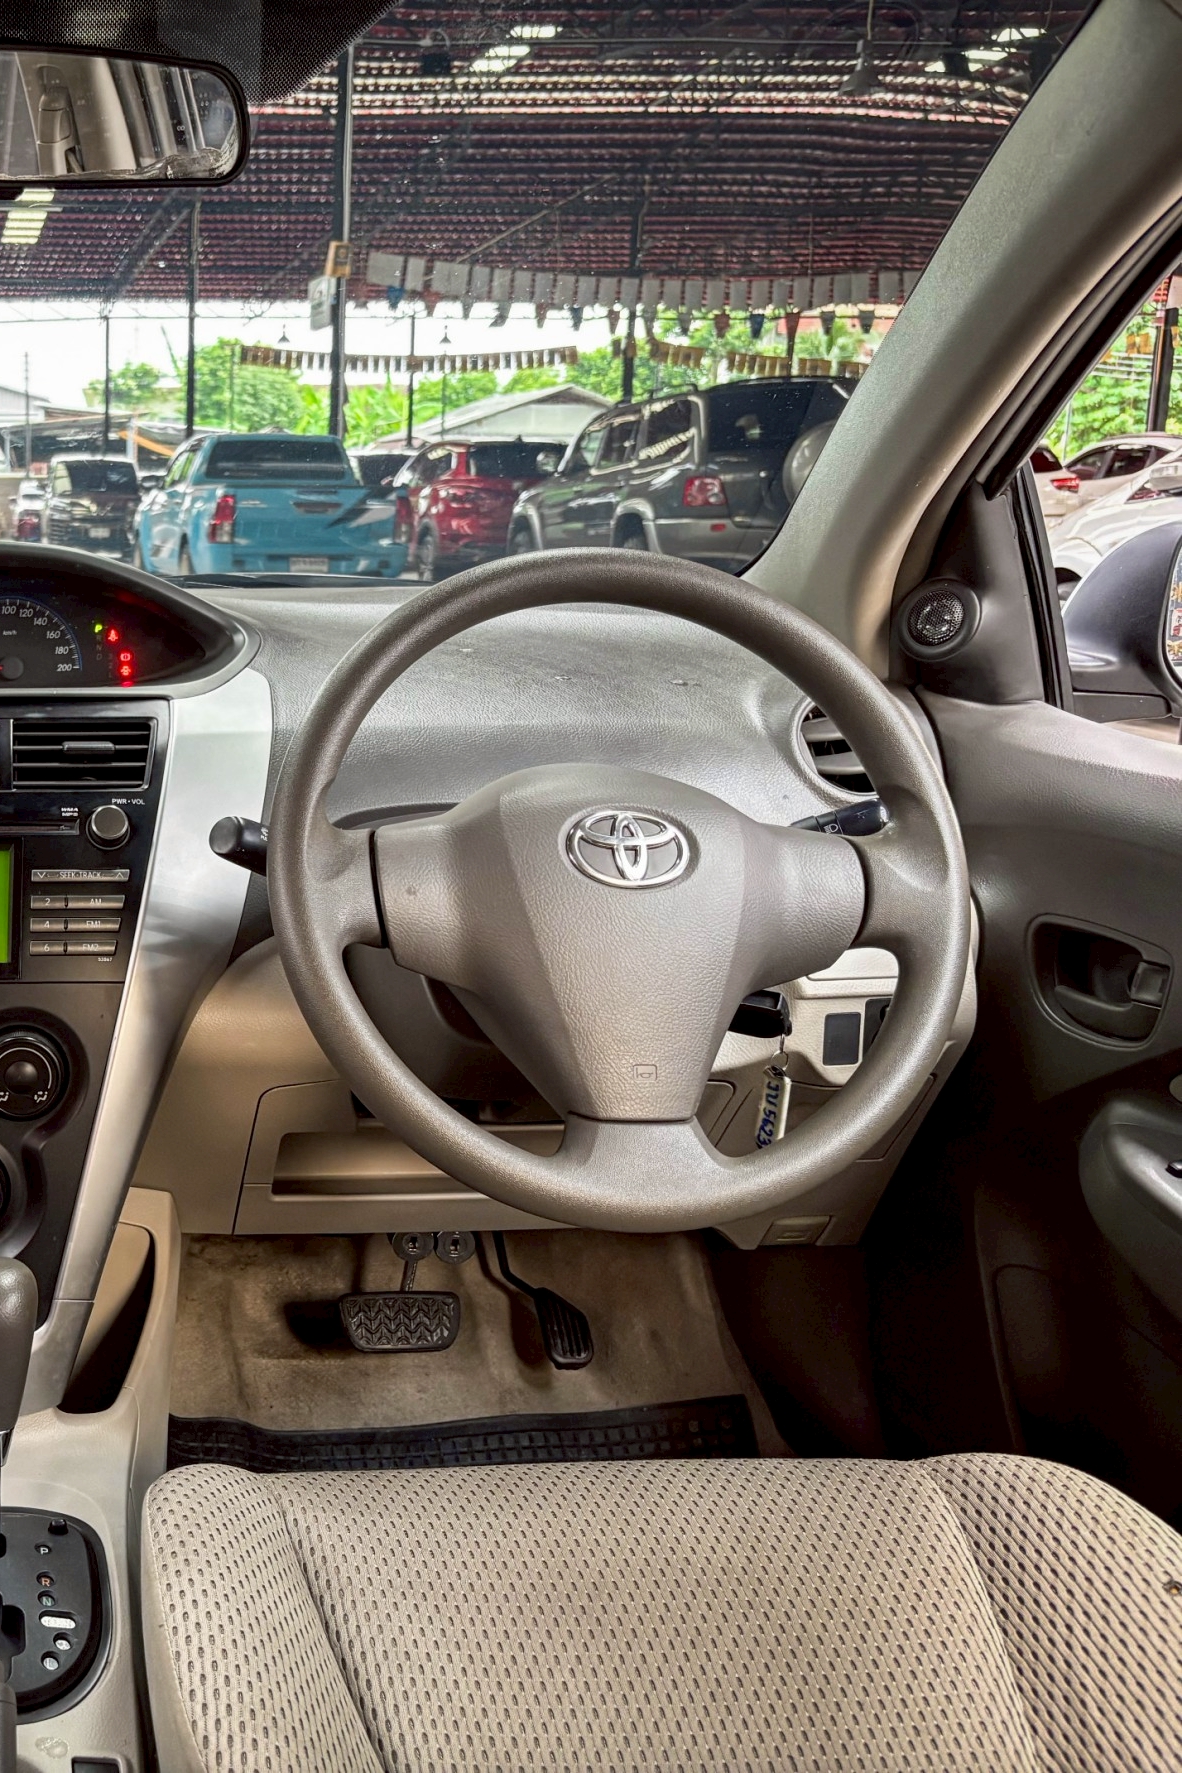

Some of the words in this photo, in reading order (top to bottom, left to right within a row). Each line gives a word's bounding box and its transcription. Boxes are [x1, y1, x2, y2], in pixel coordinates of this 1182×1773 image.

[2, 606, 16, 614] 100
[19, 608, 34, 618] 120
[33, 618, 48, 626] 140
[94, 624, 102, 633] P
[46, 630, 60, 639] 160
[54, 646, 69, 654] 180
[56, 664, 72, 672] 200
[44, 920, 50, 928] 4
[86, 920, 101, 928] FM1
[44, 944, 50, 952] 6
[82, 943, 99, 952] FM2
[40, 1547, 49, 1555] P
[42, 1577, 50, 1587] R
[42, 1596, 52, 1607] N
